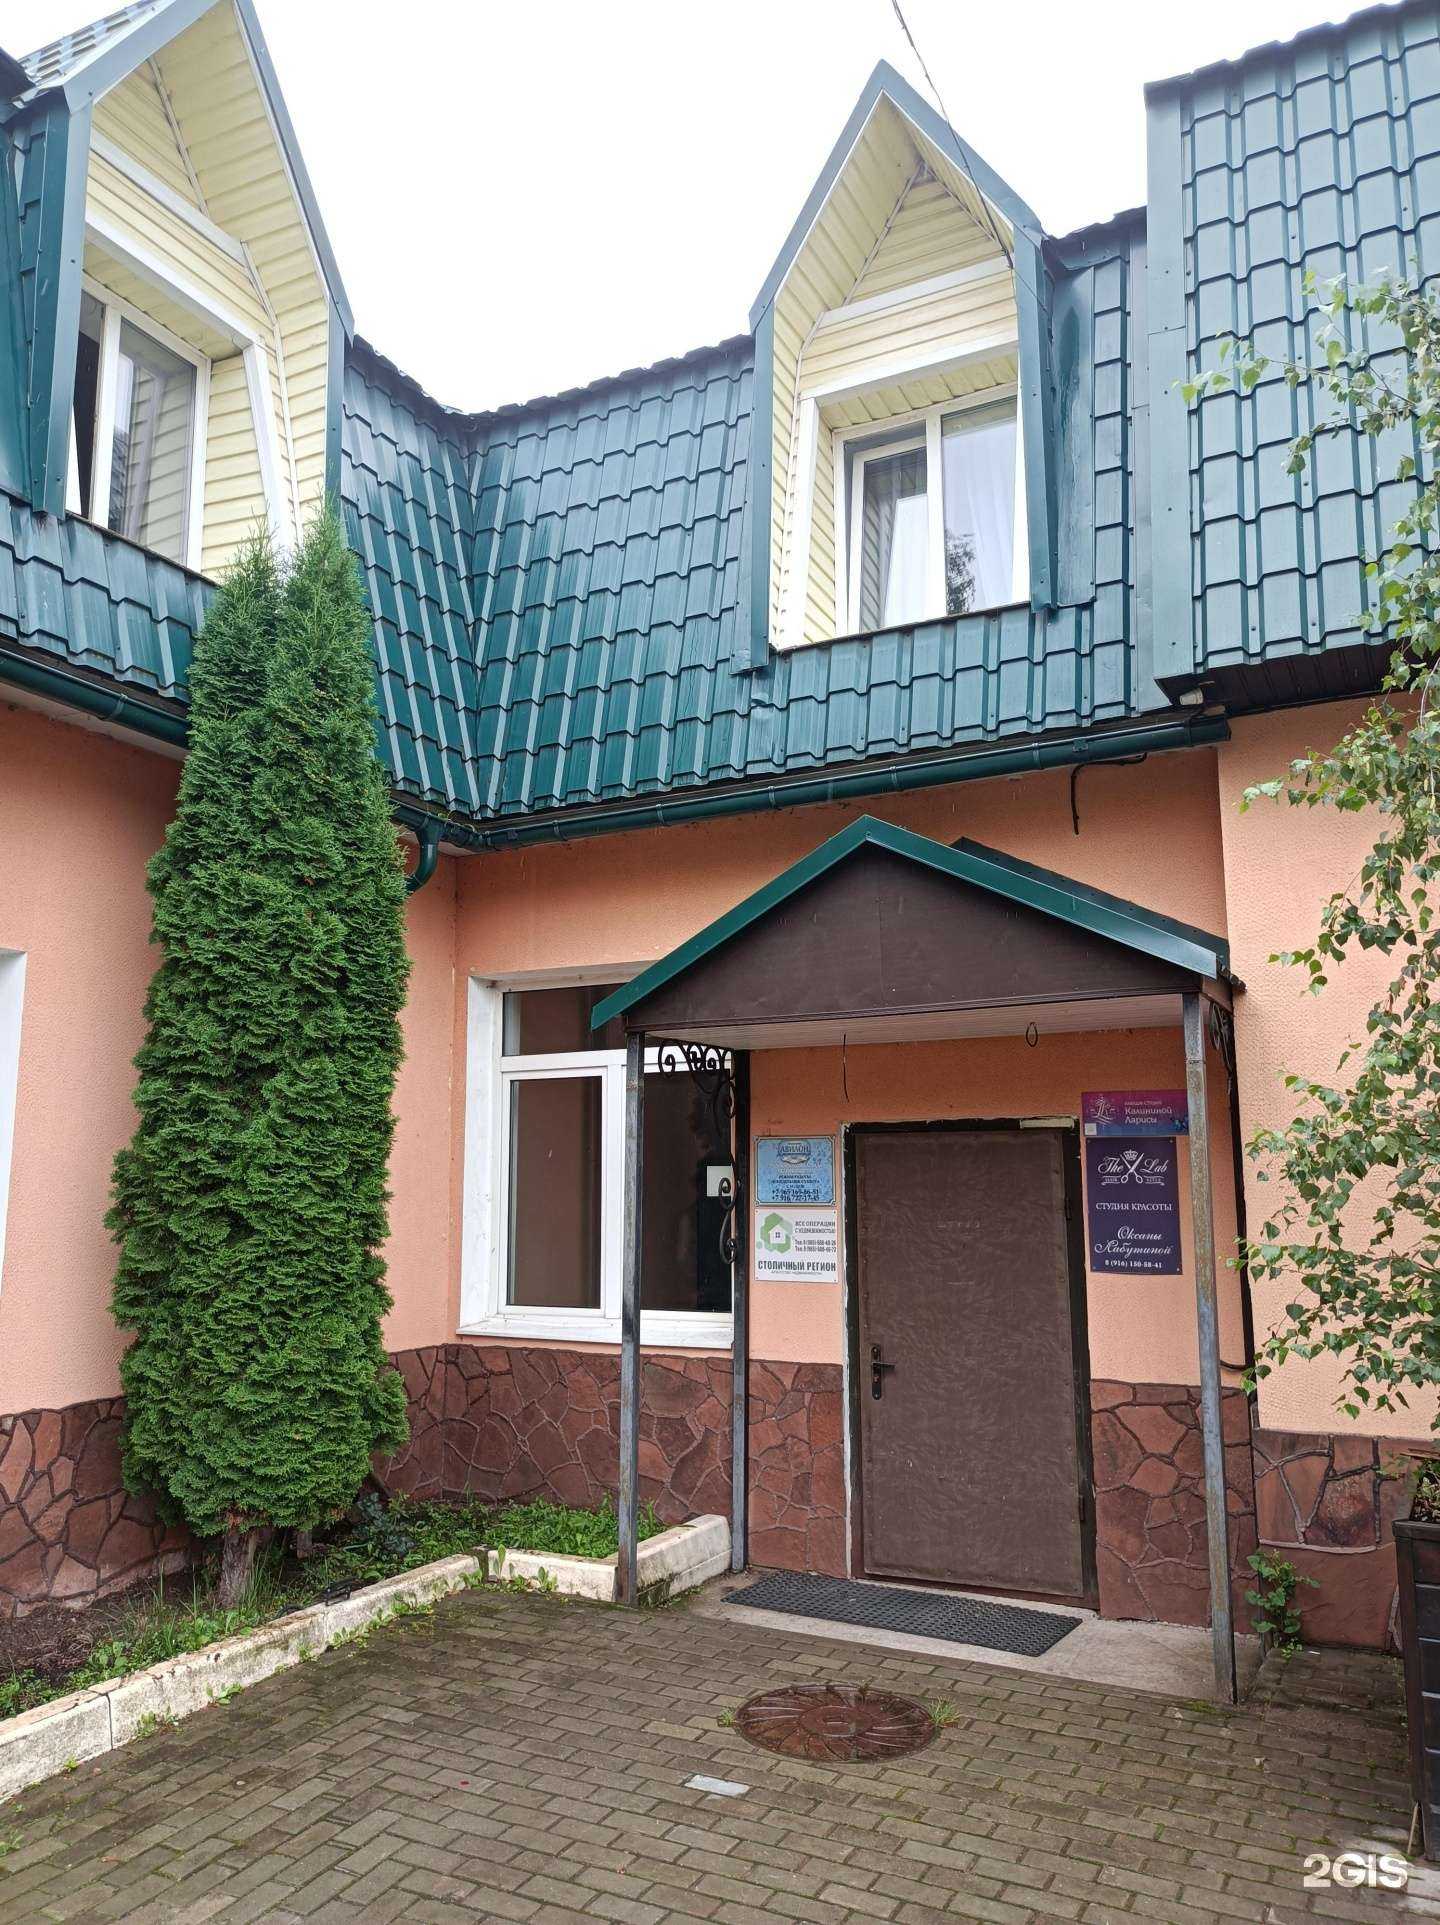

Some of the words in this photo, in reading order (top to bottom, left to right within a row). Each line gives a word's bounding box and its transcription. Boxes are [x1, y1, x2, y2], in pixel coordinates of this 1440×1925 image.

[1125, 1106, 1172, 1115] Калининой
[1125, 1116, 1157, 1125] Ларисы
[1097, 1156, 1124, 1174] The
[1140, 1158, 1169, 1173] Lab
[1095, 1202, 1129, 1210] СТУДИЯ
[1131, 1203, 1172, 1211] КРАСОТЫ
[1117, 1225, 1162, 1240] Оксаны
[758, 1260, 805, 1270] СТОЛИЧНЫЙ
[807, 1261, 836, 1271] РЕГИОН
